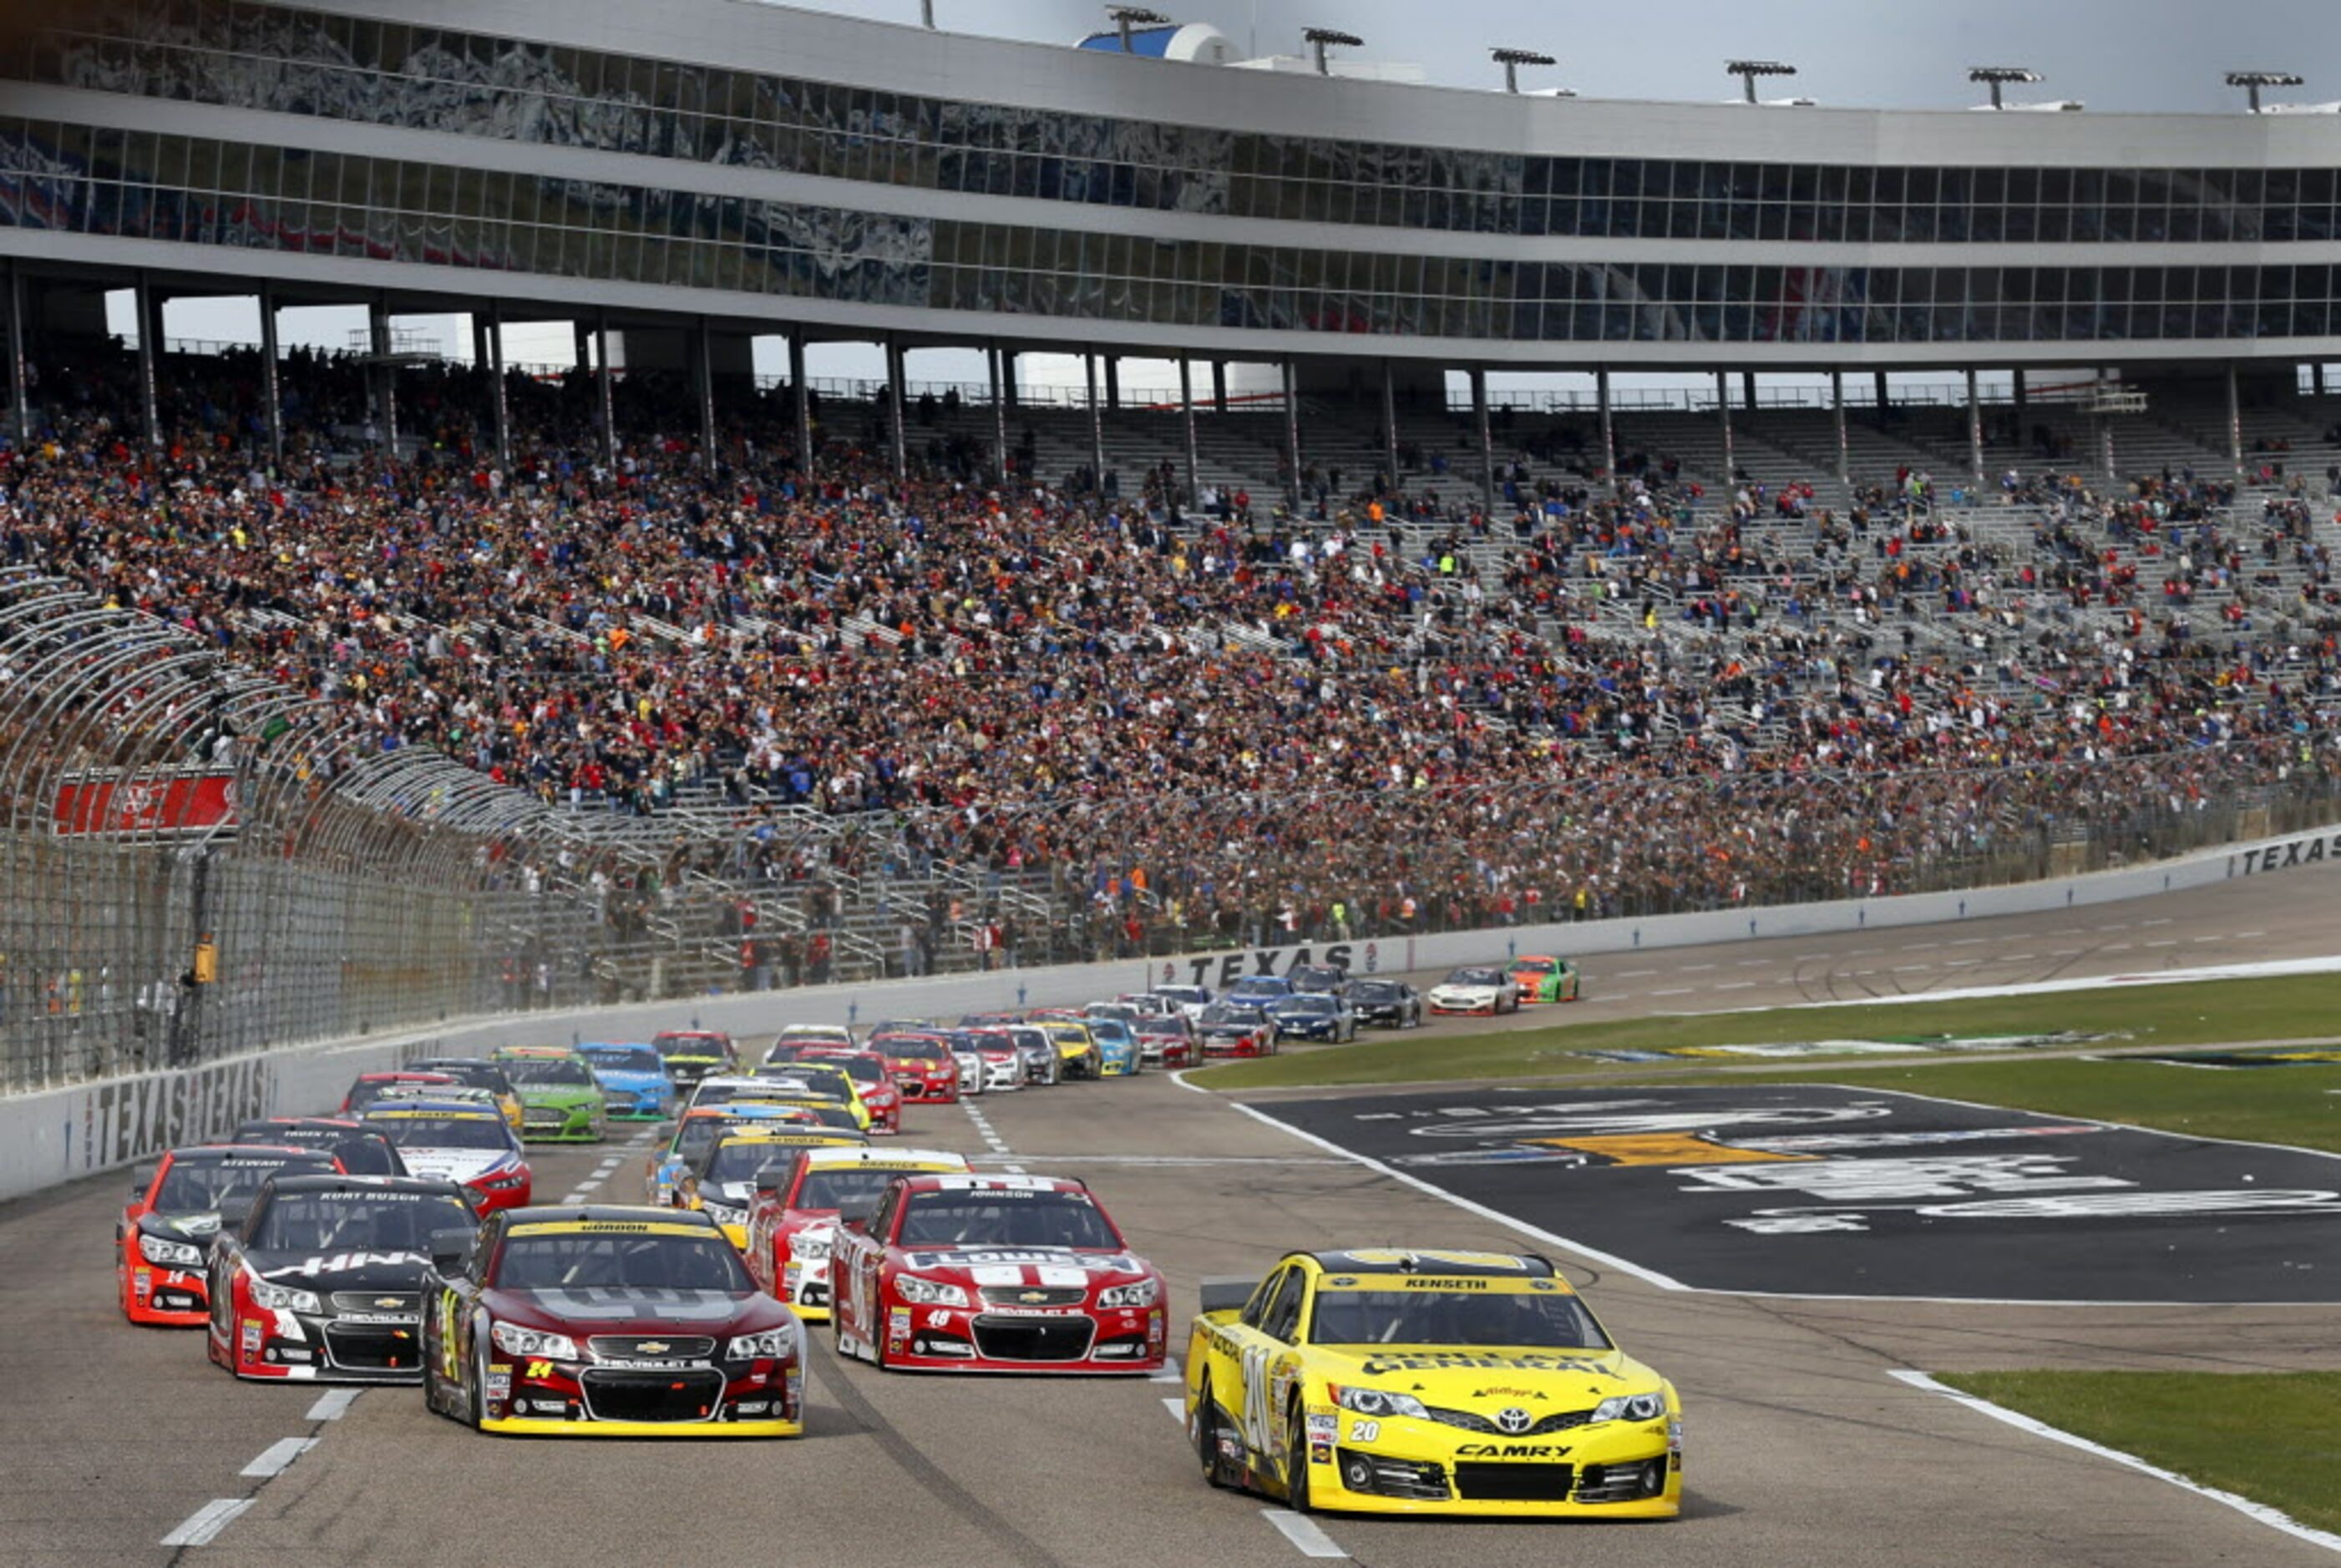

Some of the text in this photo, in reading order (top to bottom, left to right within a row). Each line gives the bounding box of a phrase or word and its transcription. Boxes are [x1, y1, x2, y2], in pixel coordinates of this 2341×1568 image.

[99, 1075, 186, 1166] TEXAS
[320, 1192, 421, 1201] KURT BUSCH
[970, 1190, 1034, 1199] JOHNSON
[1406, 1279, 1487, 1290] KENSETH
[927, 1309, 951, 1327] 48
[525, 1361, 555, 1378] 24
[593, 1359, 685, 1368] CHEVROLET
[1362, 1357, 1626, 1381] GENERAL
[1350, 1421, 1379, 1442] 20
[1456, 1444, 1573, 1457] CAMRY
